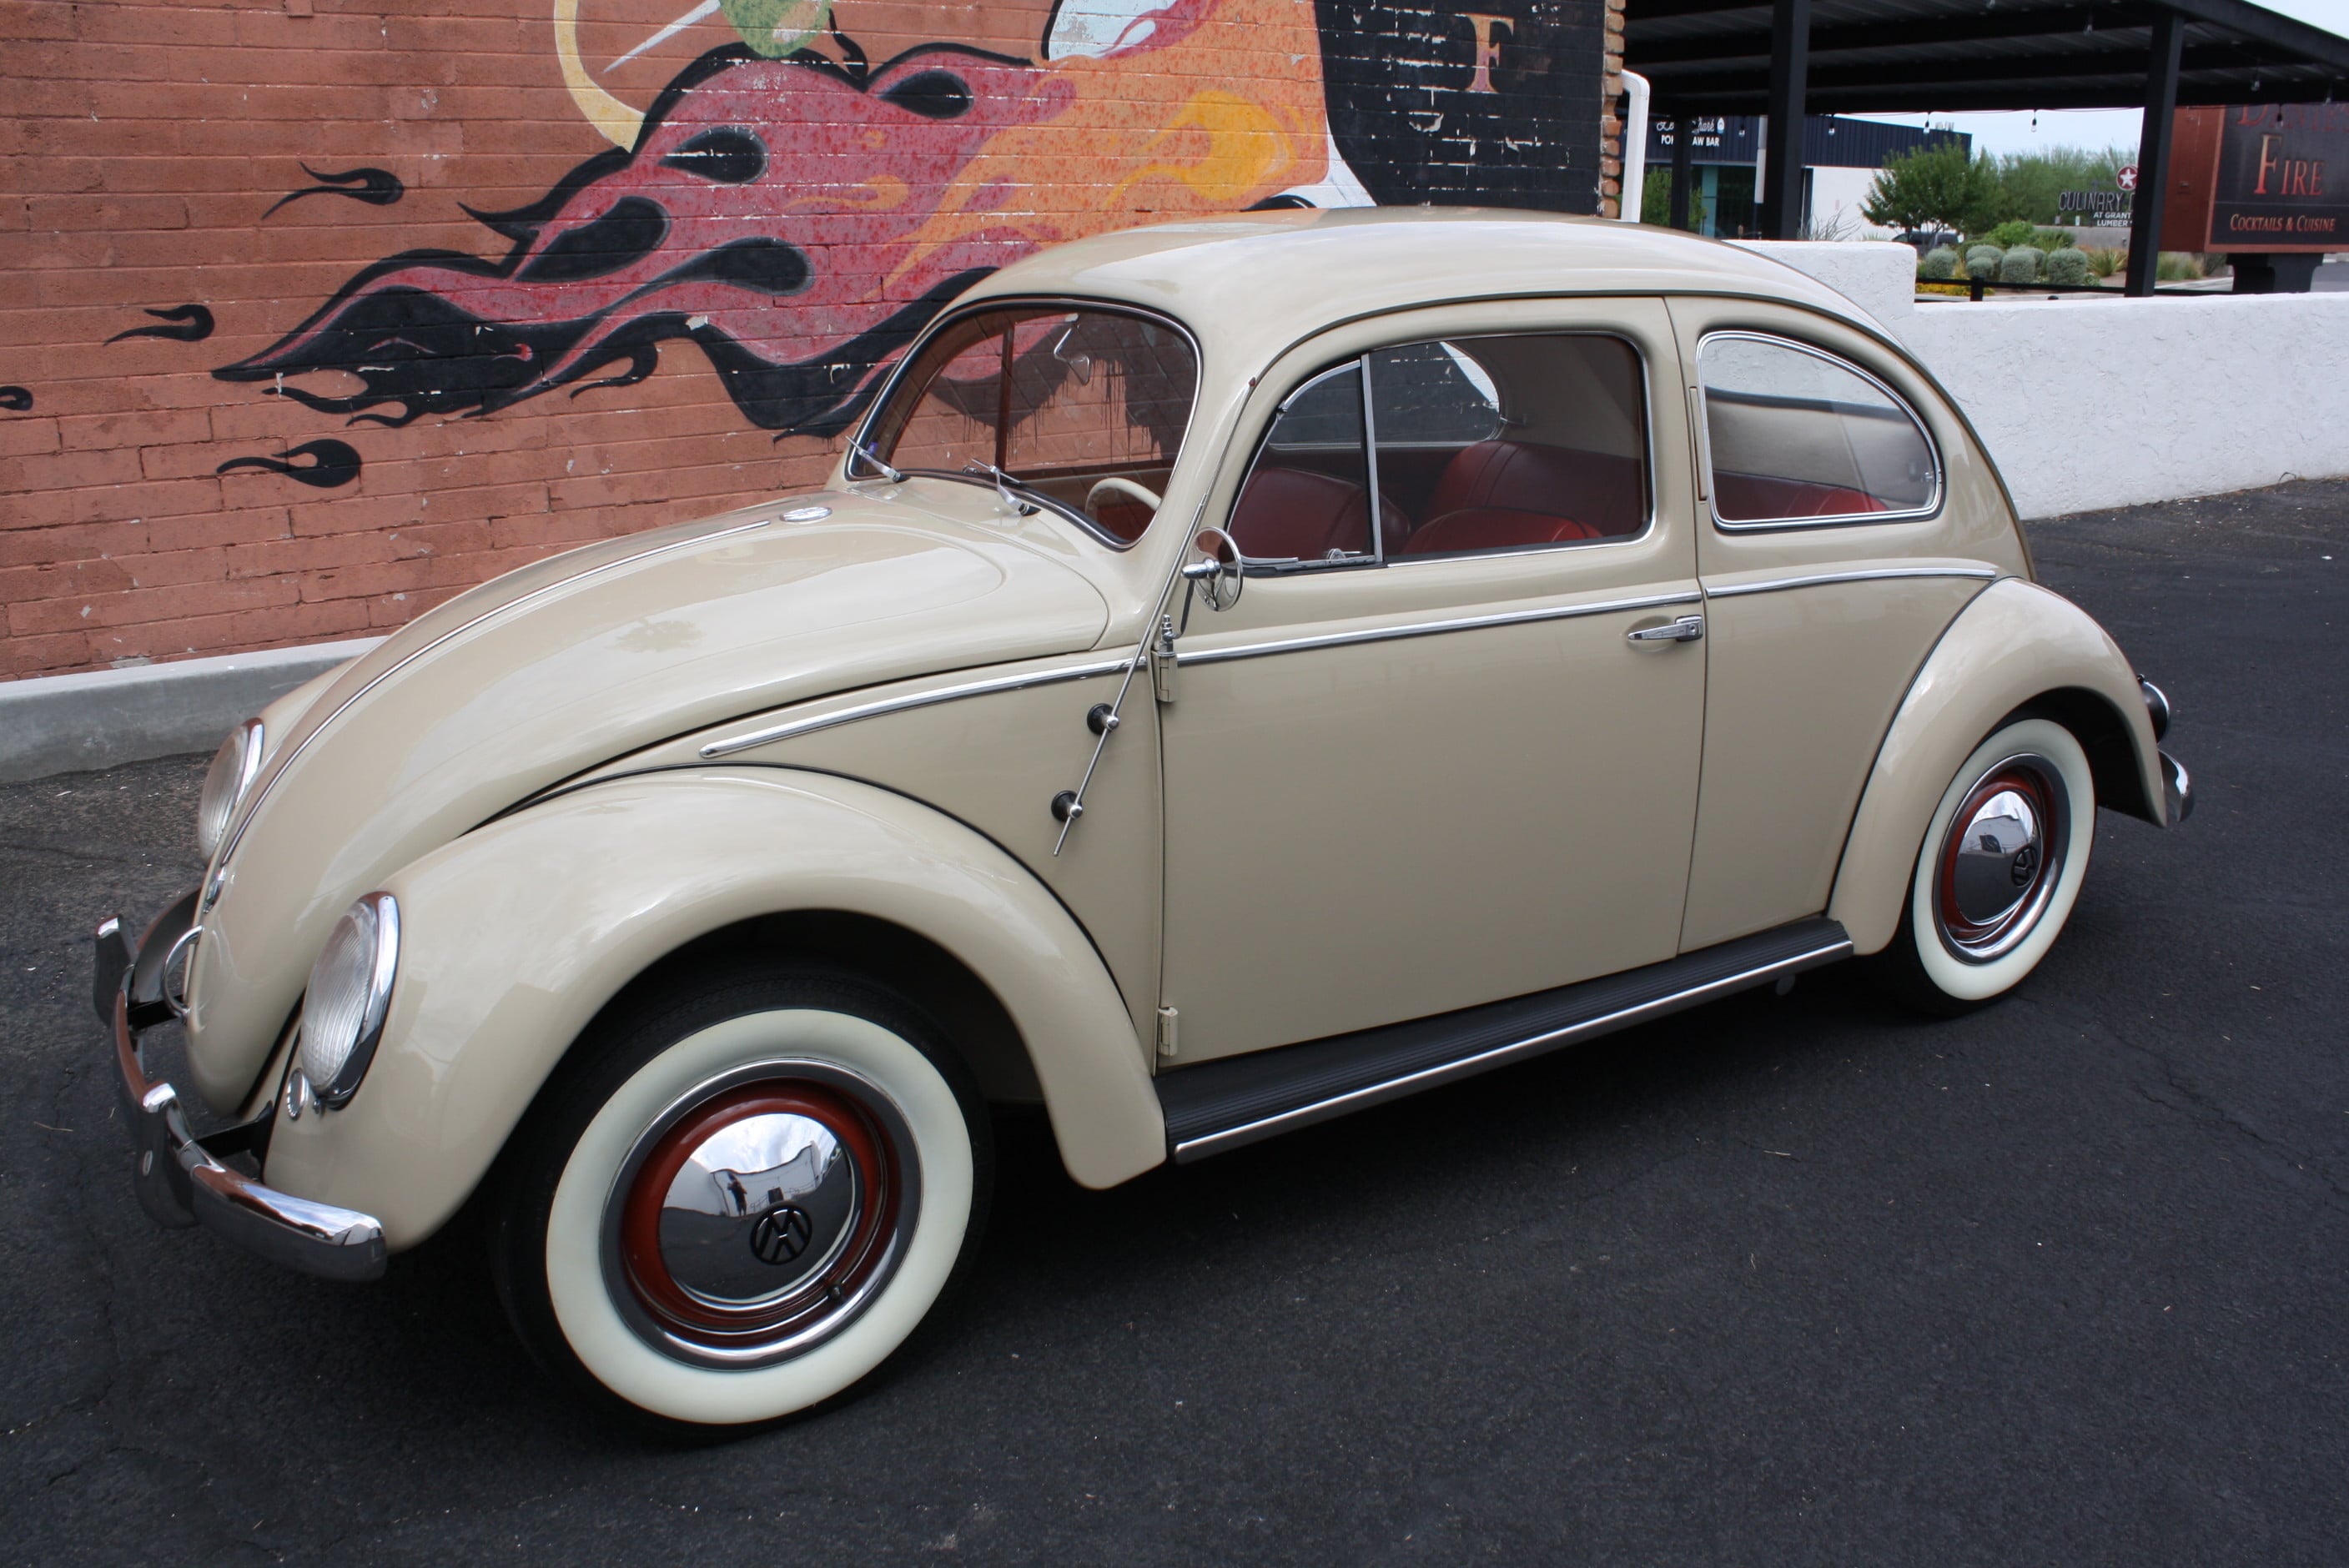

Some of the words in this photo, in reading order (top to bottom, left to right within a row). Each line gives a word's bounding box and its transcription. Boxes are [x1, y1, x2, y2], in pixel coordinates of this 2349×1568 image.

[1692, 136, 1705, 146] AW
[1706, 137, 1719, 147] BAR
[2254, 133, 2326, 195] FIRE
[2059, 192, 2124, 211] CULINARY
[2230, 214, 2283, 232] COCKTAILS
[2286, 216, 2294, 232] &
[2296, 215, 2335, 232] CUISINE
